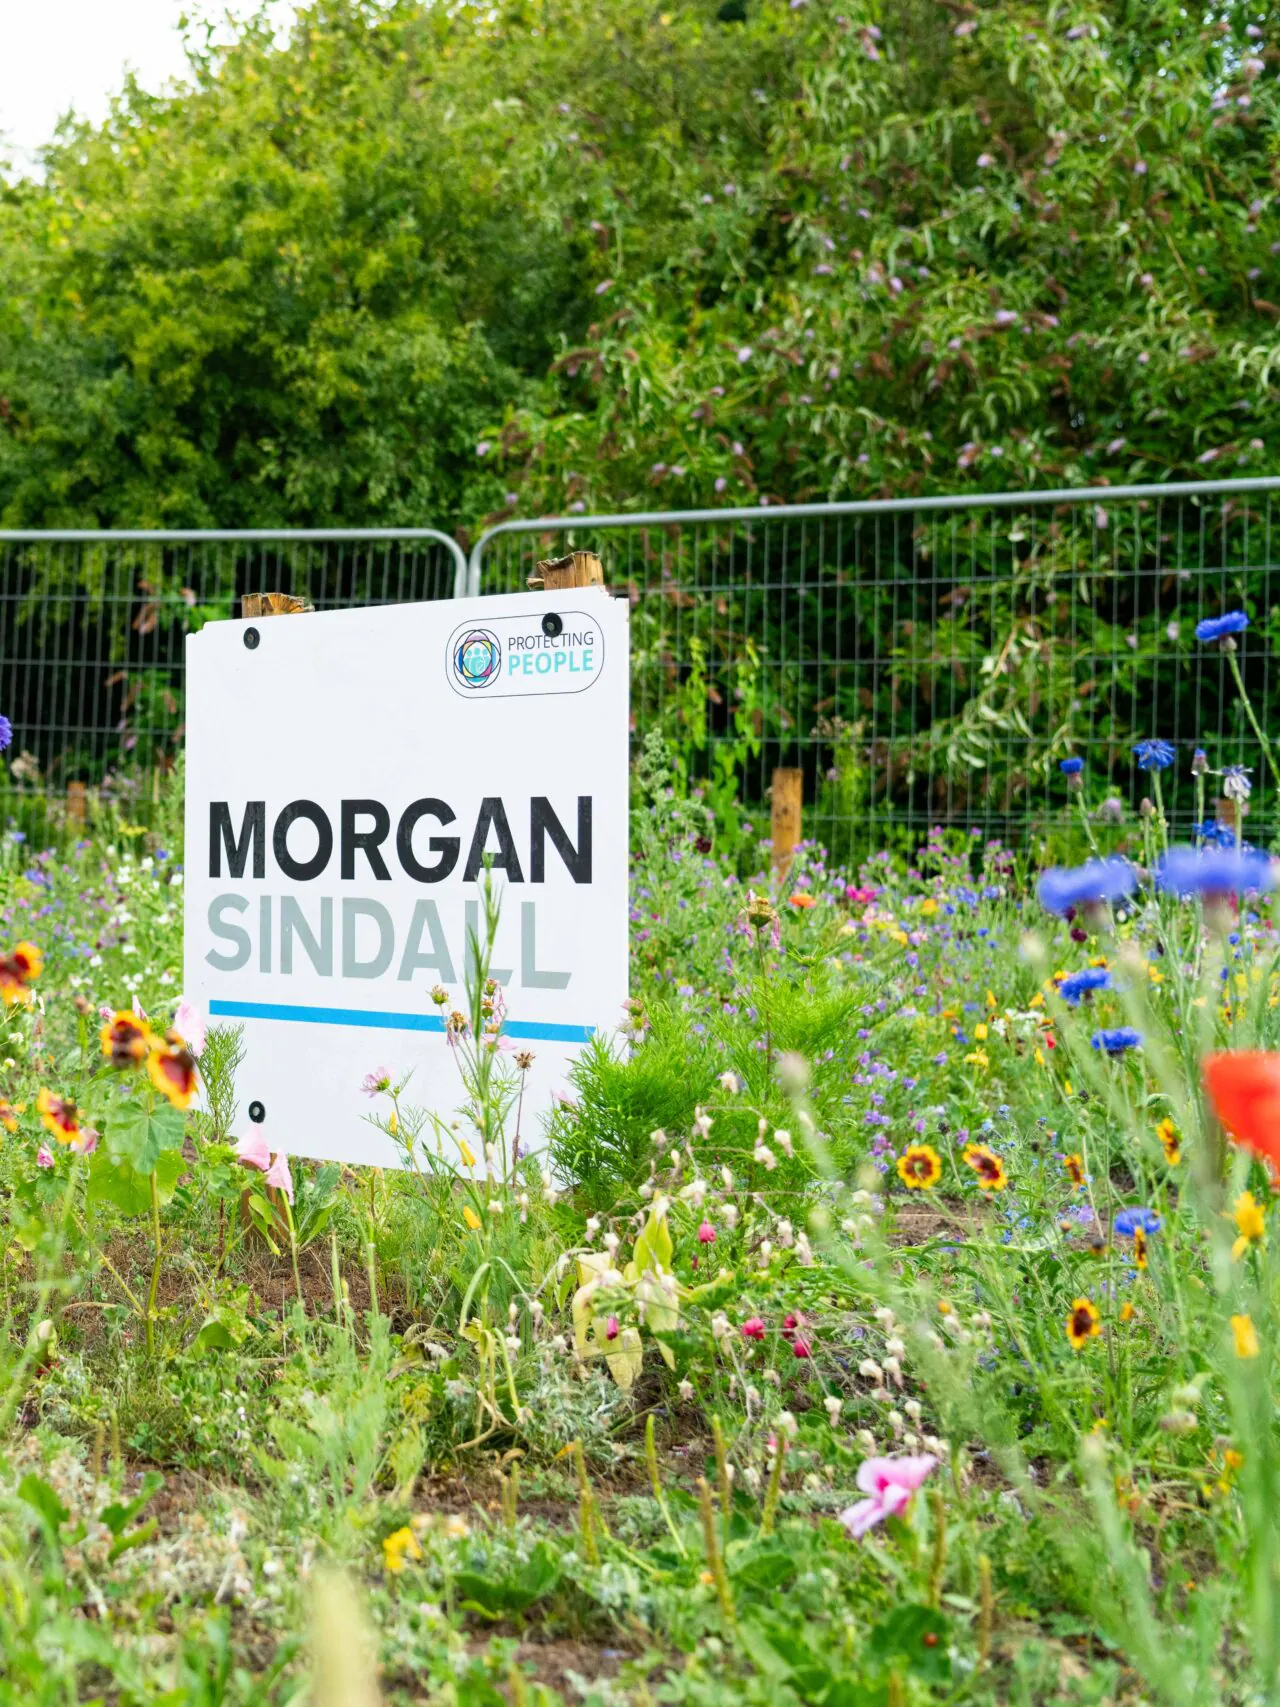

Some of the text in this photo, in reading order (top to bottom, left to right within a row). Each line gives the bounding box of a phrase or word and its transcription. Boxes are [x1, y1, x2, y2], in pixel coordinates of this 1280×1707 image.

[508, 631, 594, 651] PROTECTING
[508, 649, 593, 676] PEOPLE
[209, 795, 593, 884] MORGAN
[204, 893, 572, 989] SINDALL
